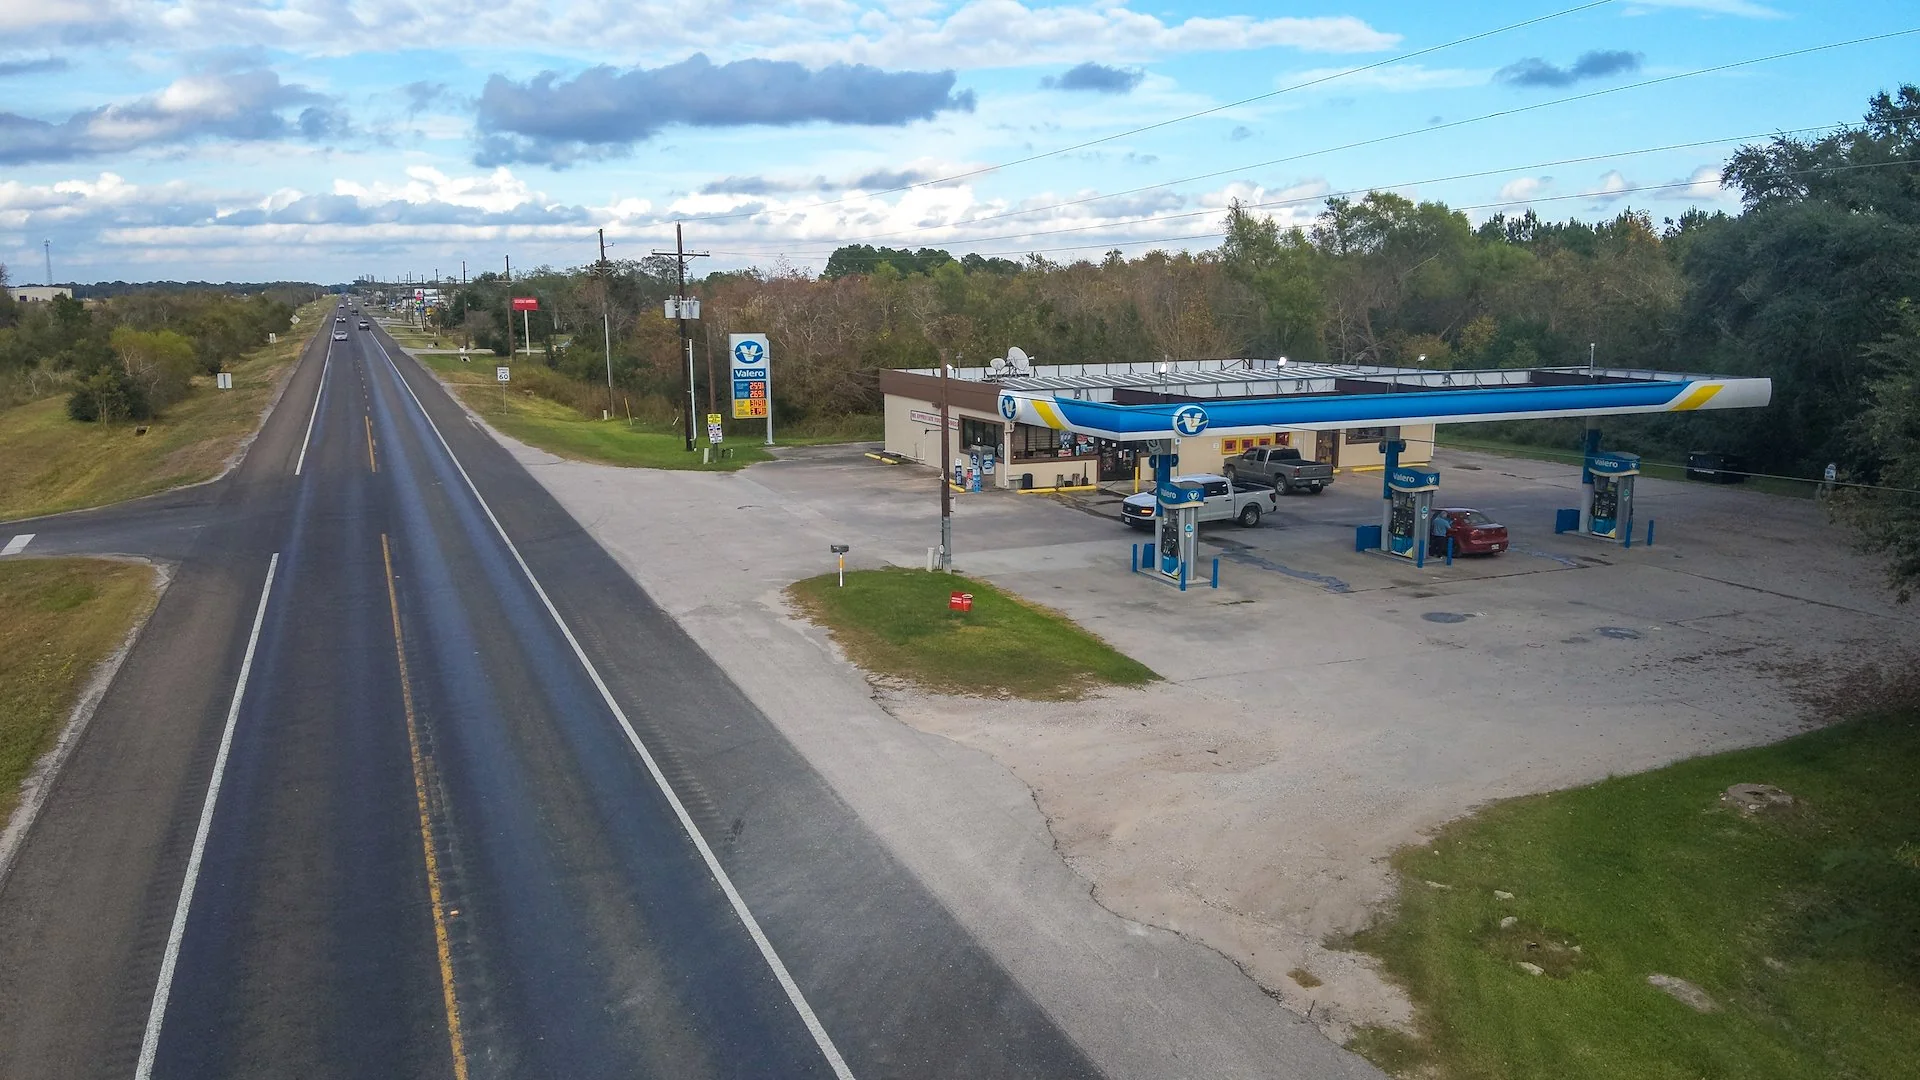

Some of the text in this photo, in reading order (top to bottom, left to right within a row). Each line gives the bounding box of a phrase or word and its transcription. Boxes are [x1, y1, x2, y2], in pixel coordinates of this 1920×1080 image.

[735, 370, 764, 378] Valero
[1594, 459, 1618, 468] Valero
[1393, 472, 1415, 483] Valero
